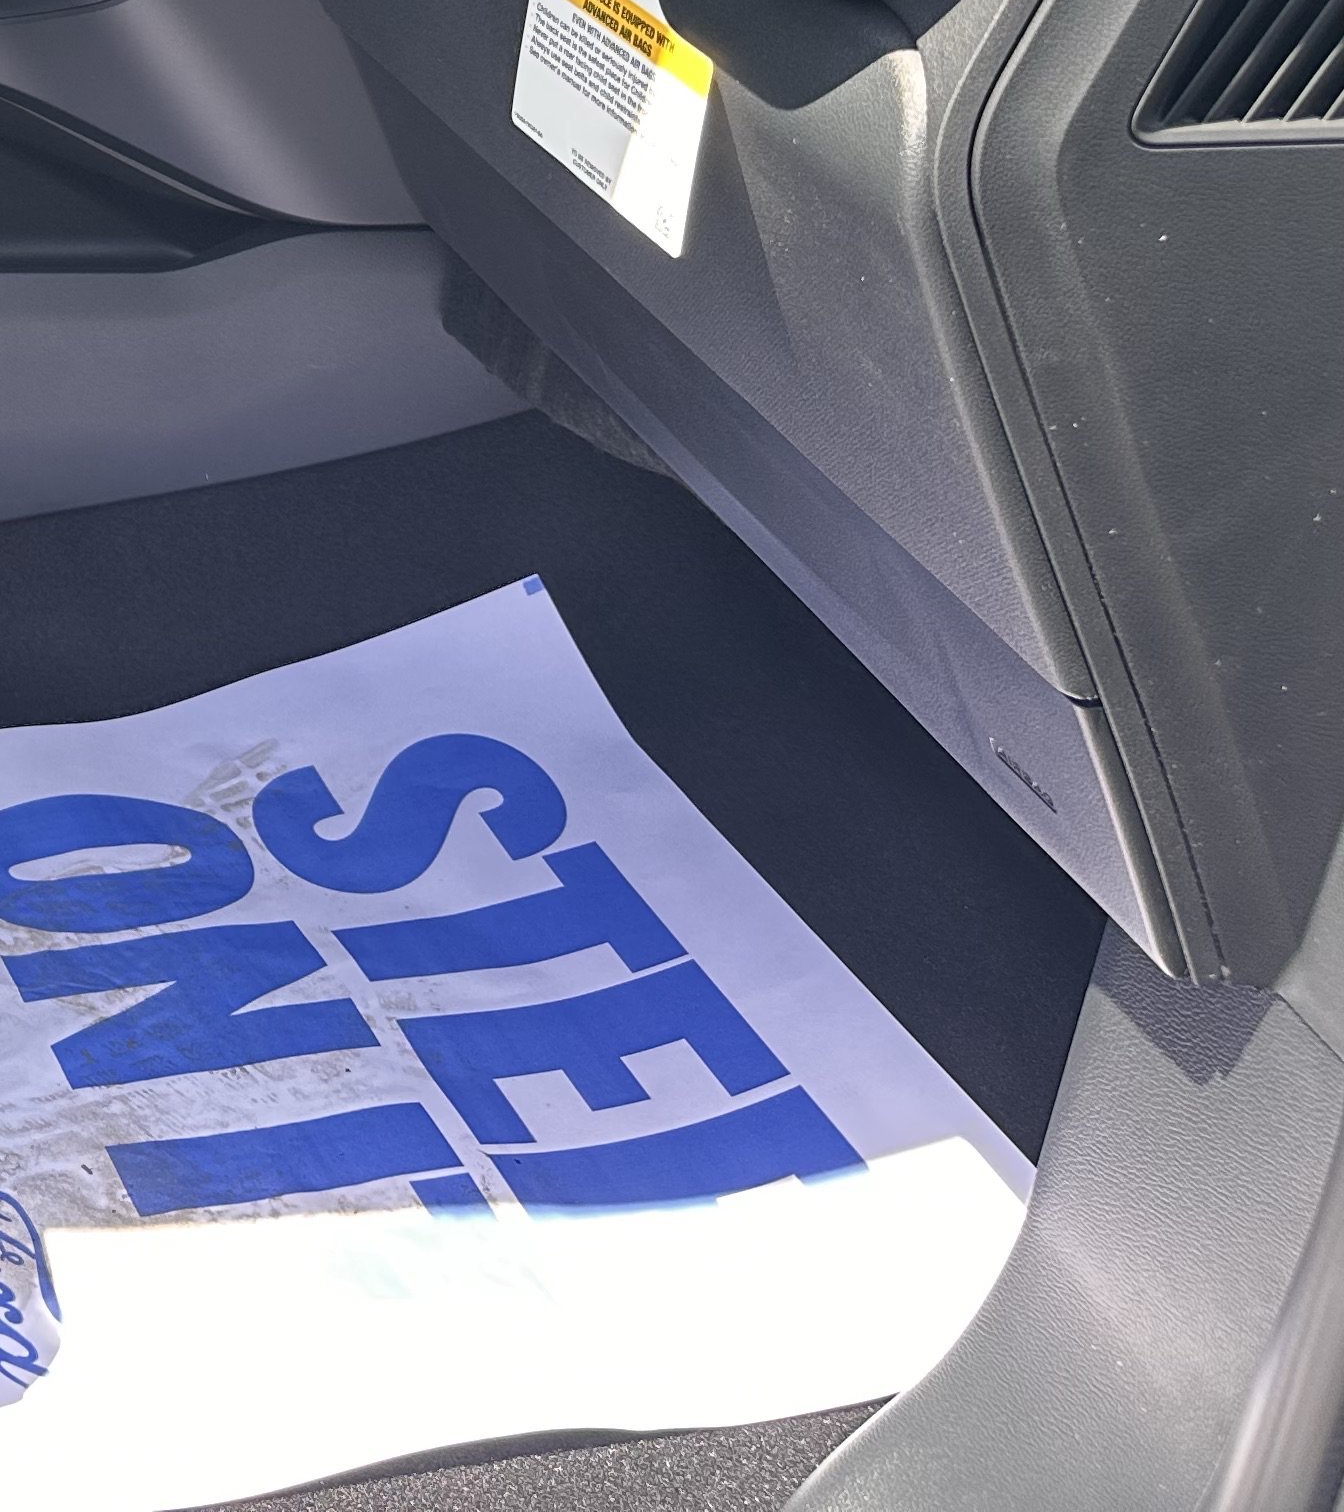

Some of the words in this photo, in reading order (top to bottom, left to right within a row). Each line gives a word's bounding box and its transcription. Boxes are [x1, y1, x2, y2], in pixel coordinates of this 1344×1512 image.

[572, 11, 586, 30] EVEN
[601, 33, 630, 63] ADVANCED
[630, 55, 640, 71] AIR
[612, 0, 620, 15] IS
[620, 5, 655, 41] EQUIPPED
[655, 30, 674, 55] WITH
[619, 24, 632, 43] AIR
[632, 33, 652, 58] BAGS
[105, 1101, 498, 1220] I
